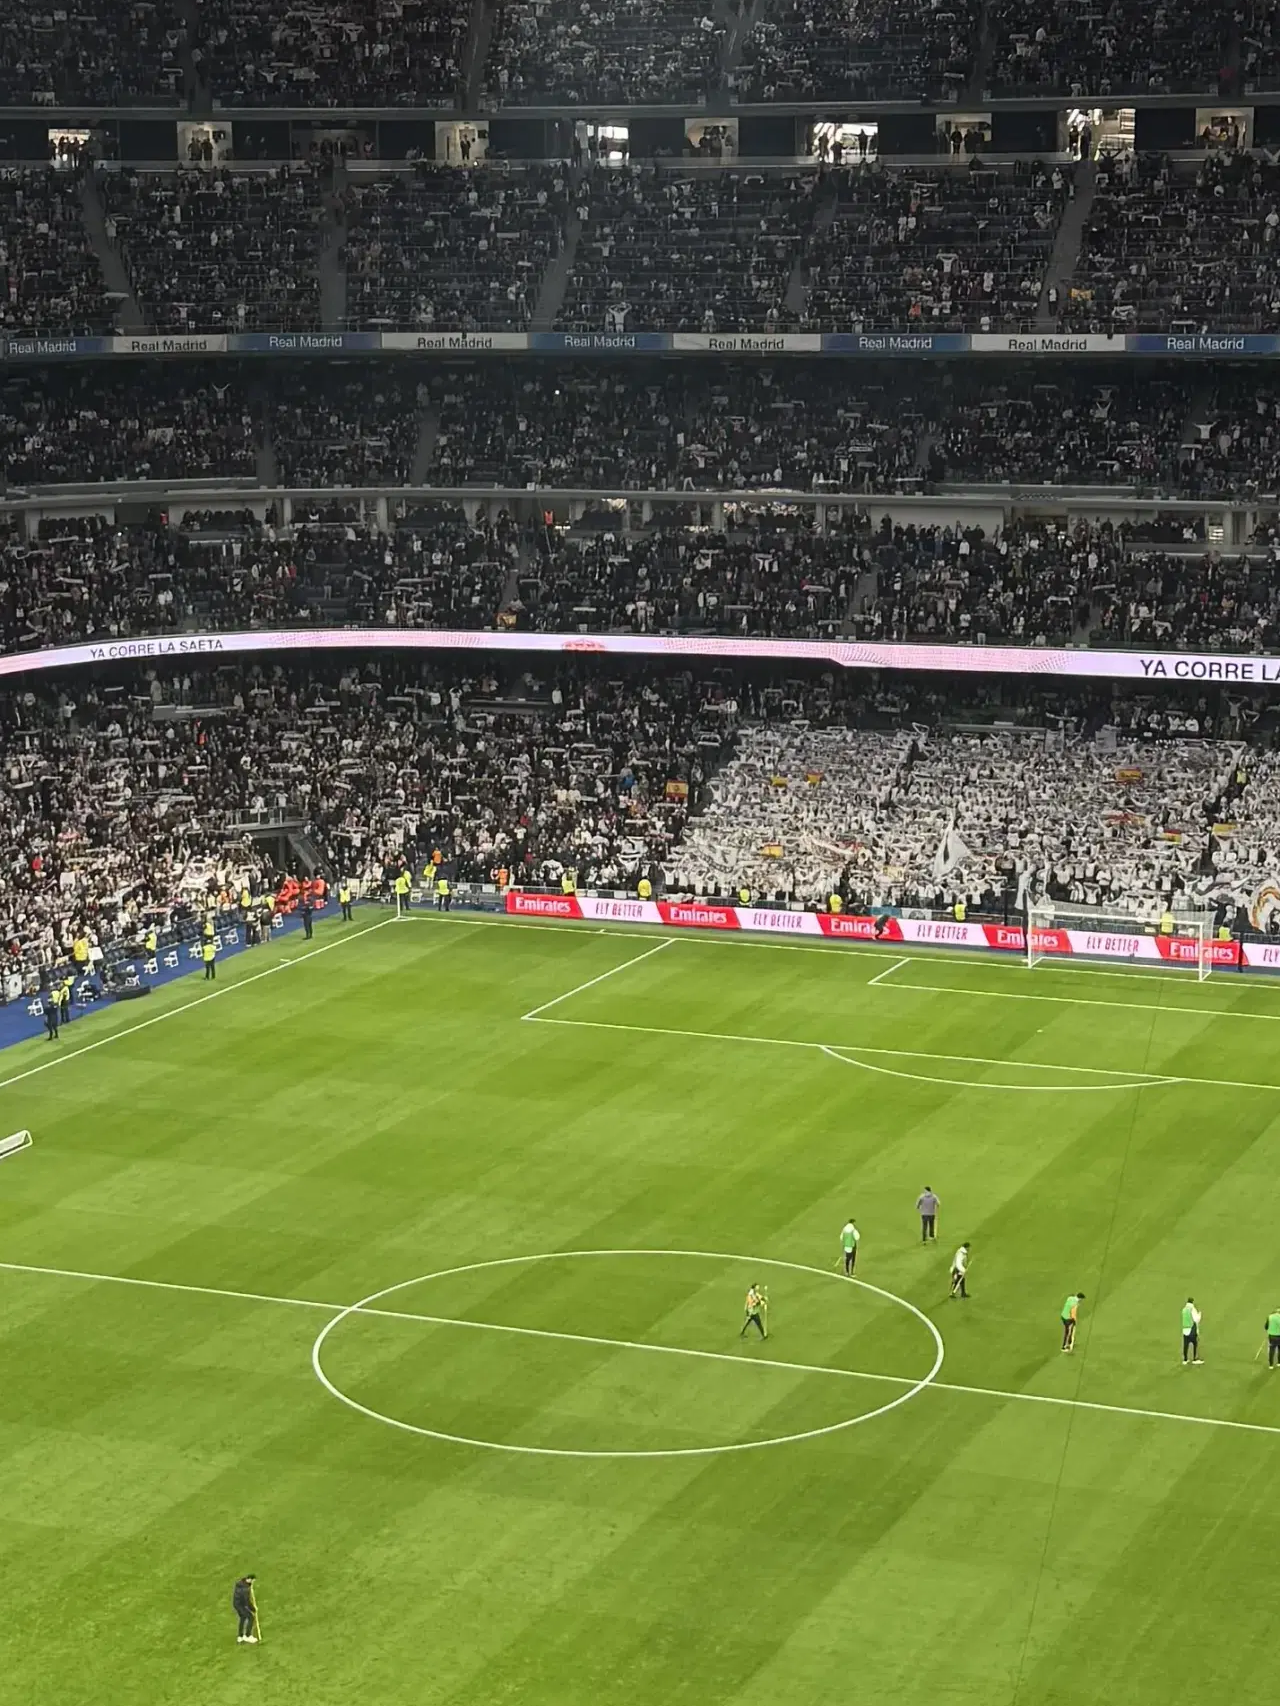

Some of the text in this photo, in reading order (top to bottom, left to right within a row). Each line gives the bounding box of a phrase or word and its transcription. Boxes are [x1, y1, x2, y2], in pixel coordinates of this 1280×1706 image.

[10, 340, 77, 353] Real Madrid
[131, 339, 208, 352] Real Madrid
[270, 335, 343, 348] Real Madrid
[418, 336, 492, 348] Real Madrid
[565, 335, 635, 348] Real Madrid
[709, 336, 784, 350] Real Madrid
[859, 336, 932, 348] Real Madrid
[1008, 337, 1087, 351] Real Madrid
[1167, 336, 1245, 349] Real Madrid
[91, 639, 223, 659] YA CORRE LA SAETA
[1140, 659, 1167, 676] YA
[1175, 660, 1254, 680] CORRE
[515, 895, 571, 913] Emirates
[596, 901, 643, 918] FLY BETTER
[670, 906, 727, 924] Emirates
[754, 912, 803, 928] FLY BETTER
[830, 917, 890, 936] Emiras
[917, 924, 969, 940] FLY BETTER
[997, 931, 1058, 948] Emiates
[1086, 936, 1139, 953] FLY BETTER
[1170, 943, 1233, 961] Emiates
[1263, 949, 1280, 963] FLY
